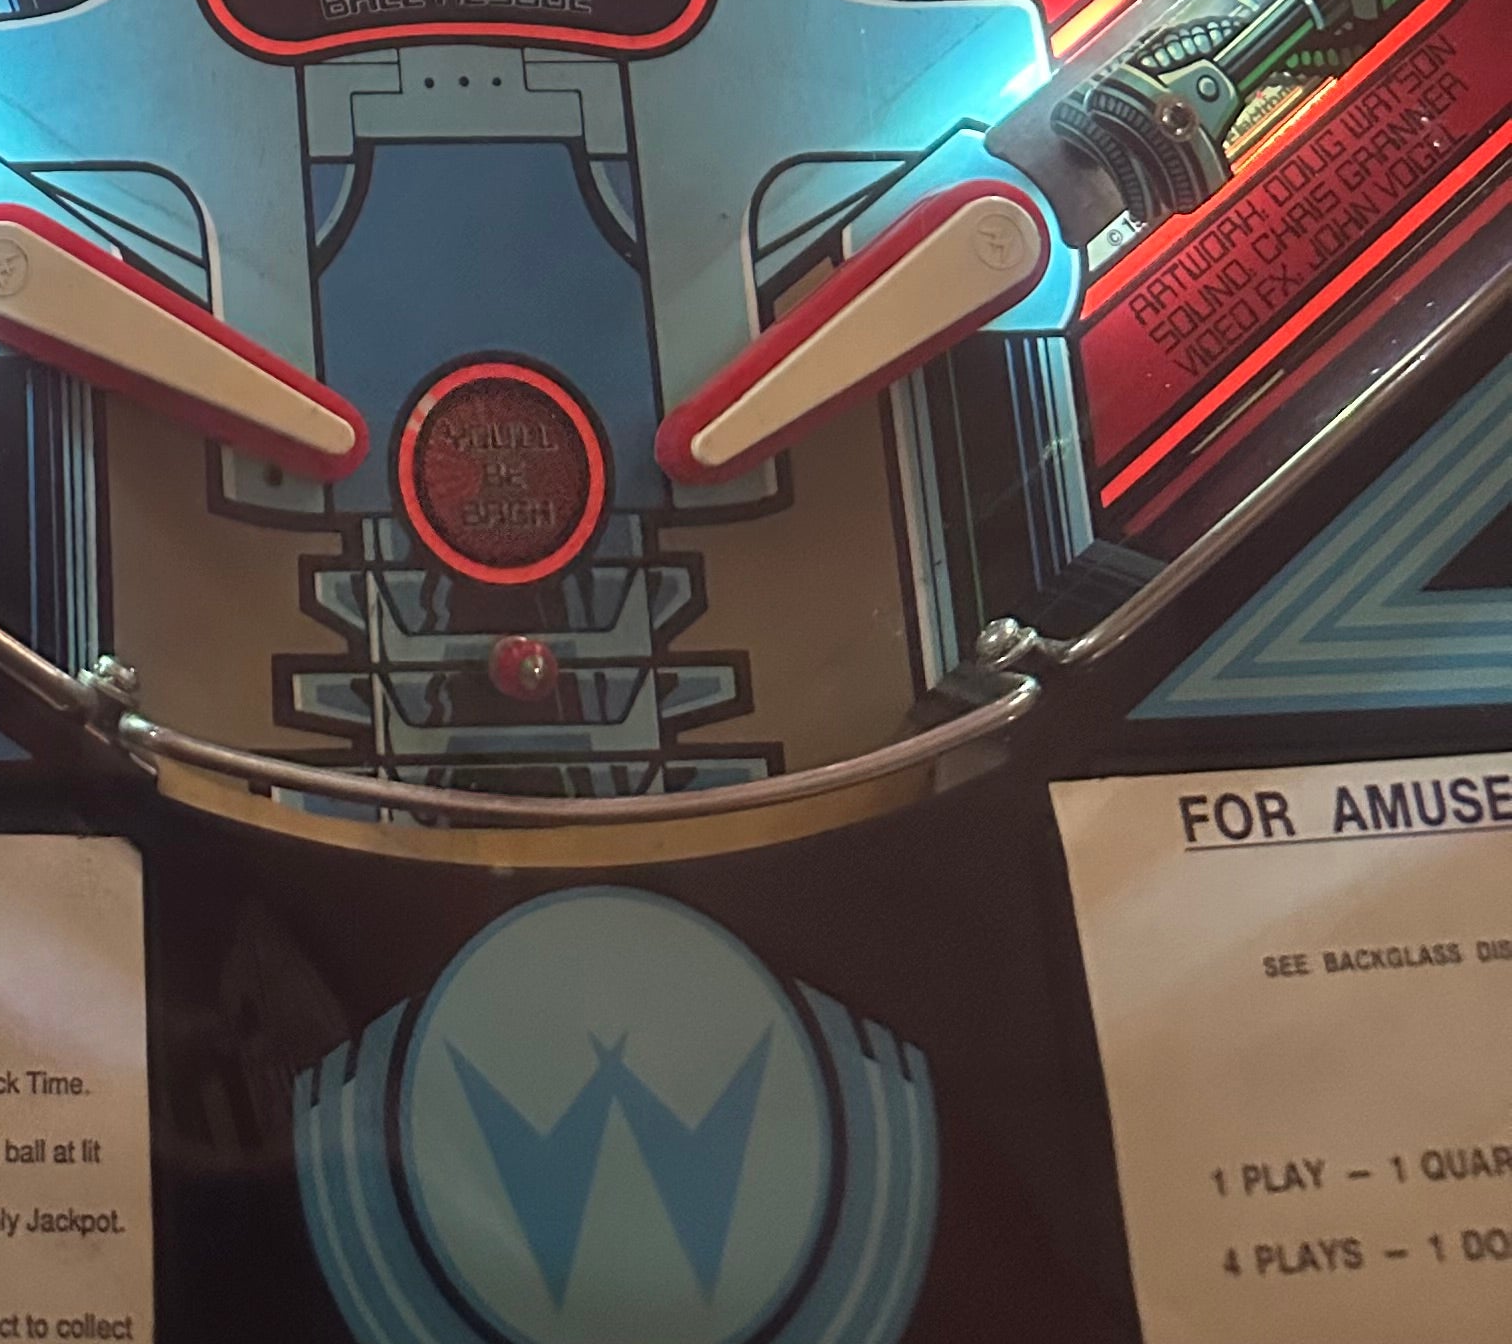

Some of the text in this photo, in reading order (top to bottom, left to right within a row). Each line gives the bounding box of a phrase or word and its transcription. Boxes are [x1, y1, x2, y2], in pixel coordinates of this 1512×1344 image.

[1262, 128, 1347, 208] DOUG
[1340, 33, 1457, 139] WATSON
[1250, 181, 1342, 265] CHRIS
[1334, 71, 1470, 192] GRANNER
[1173, 298, 1260, 377] VIDEO
[1307, 190, 1382, 272] JOHN
[1374, 123, 1469, 199] VOGEL
[1179, 790, 1296, 843] FOR
[1263, 954, 1311, 978] SEE
[1322, 942, 1464, 974] BACKGLASS
[27, 1070, 90, 1096] Time.
[5, 1138, 45, 1164] ball
[52, 1140, 76, 1164] at
[81, 1139, 102, 1164] lit
[1211, 1167, 1228, 1197] 1
[1241, 1157, 1326, 1197] PLAY
[1390, 1154, 1407, 1184] 1
[26, 1209, 126, 1238] Jackpot.
[1223, 1245, 1243, 1278] 4
[1254, 1235, 1365, 1278] PLAYS
[1428, 1232, 1446, 1263] 1
